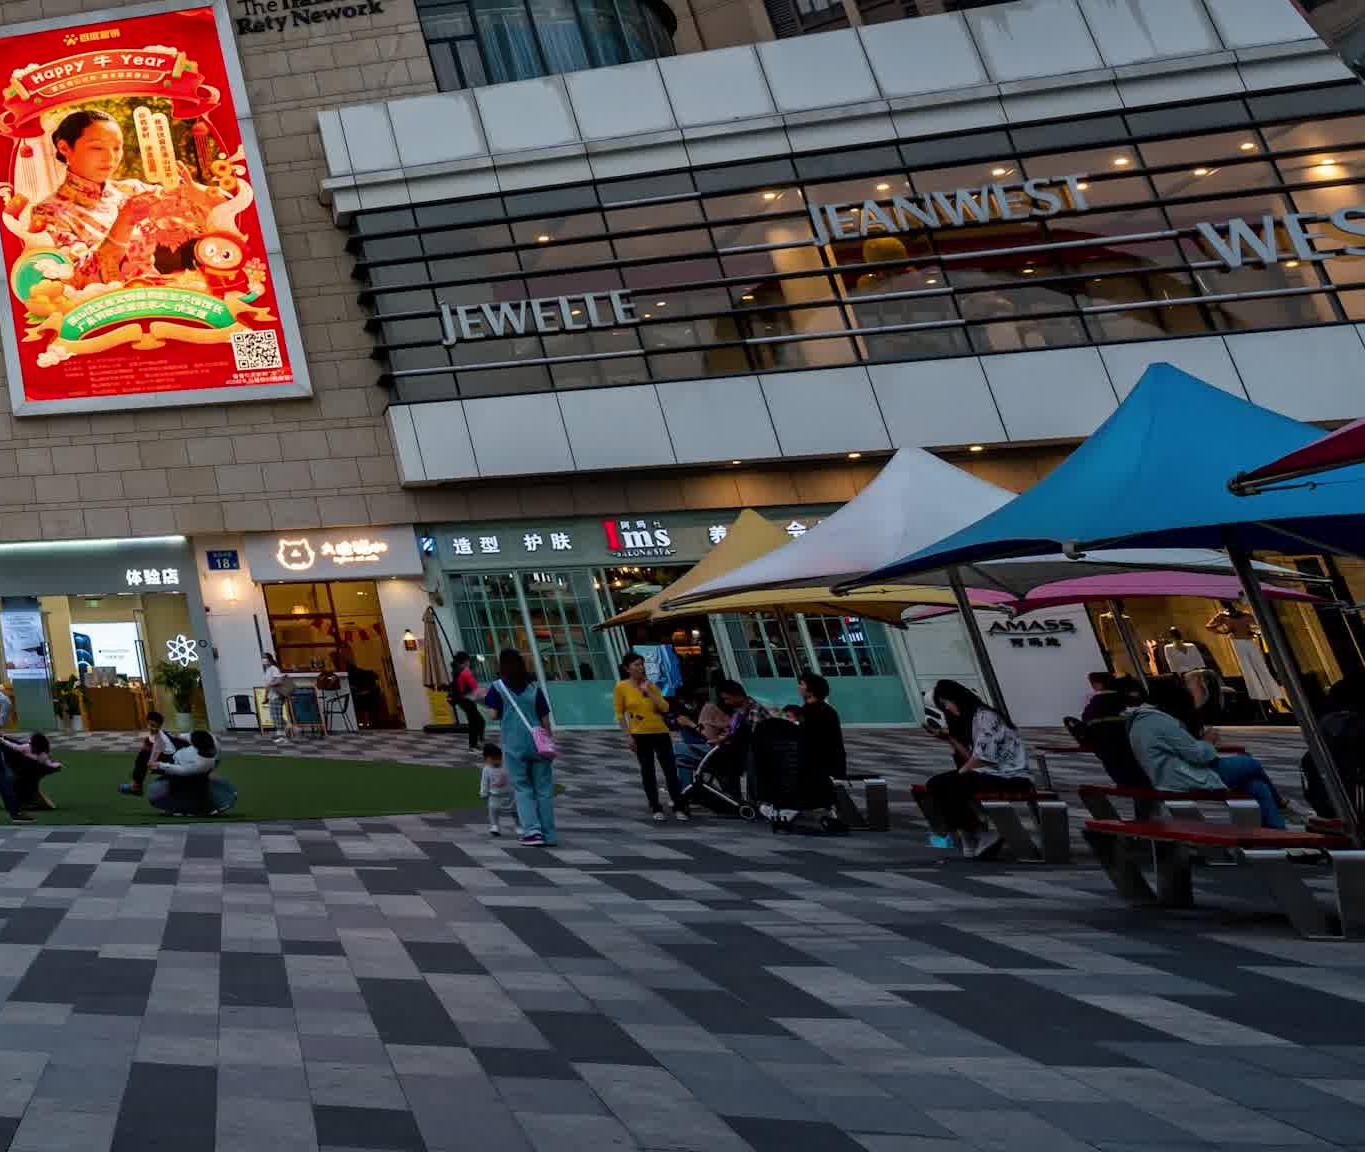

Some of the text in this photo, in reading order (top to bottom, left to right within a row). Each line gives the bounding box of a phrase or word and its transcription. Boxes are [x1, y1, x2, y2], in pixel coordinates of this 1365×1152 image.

[31, 59, 85, 85] Happy
[92, 53, 113, 69] 牛
[120, 53, 166, 68] Year
[809, 172, 1091, 246] JEANWEST
[452, 531, 573, 556] 造型 护肤
[125, 567, 181, 586] 体验店
[988, 618, 1076, 635] AMASS
